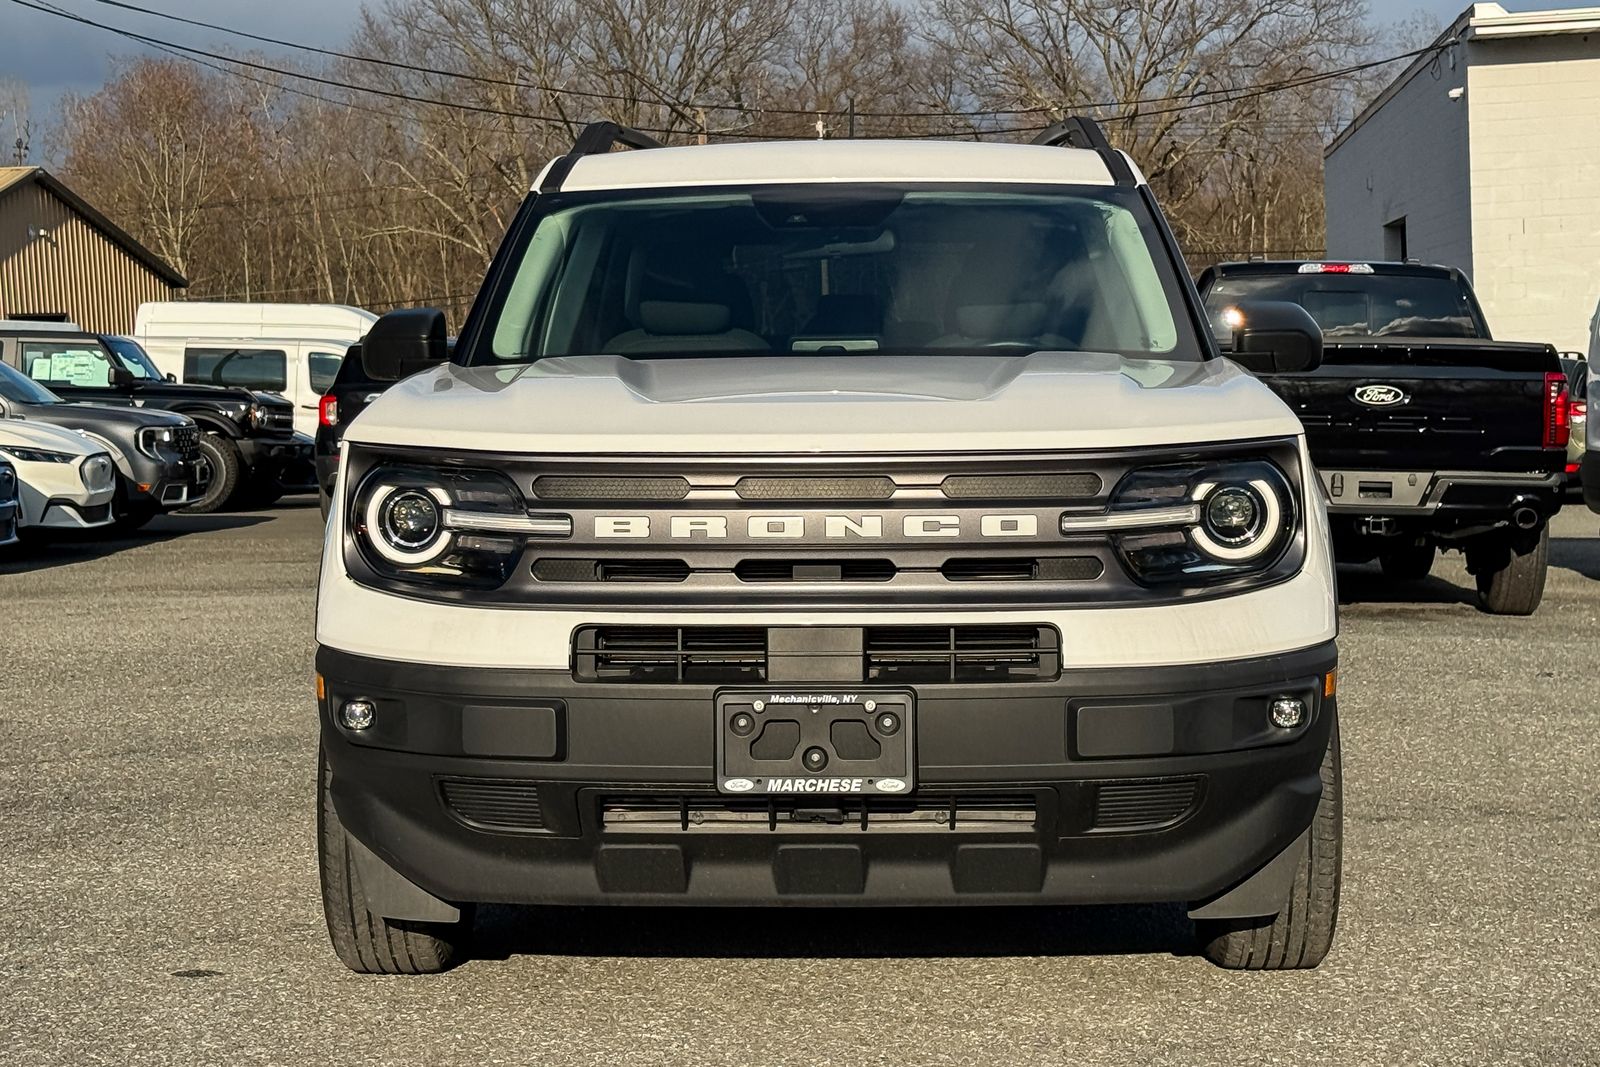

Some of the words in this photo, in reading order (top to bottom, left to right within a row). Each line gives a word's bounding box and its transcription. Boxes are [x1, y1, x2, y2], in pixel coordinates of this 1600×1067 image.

[1362, 387, 1396, 402] Ford
[594, 515, 1038, 538] BRONCO
[770, 694, 840, 704] Mechanicville,
[842, 694, 859, 703] NY
[767, 778, 863, 792] MARCHESE
